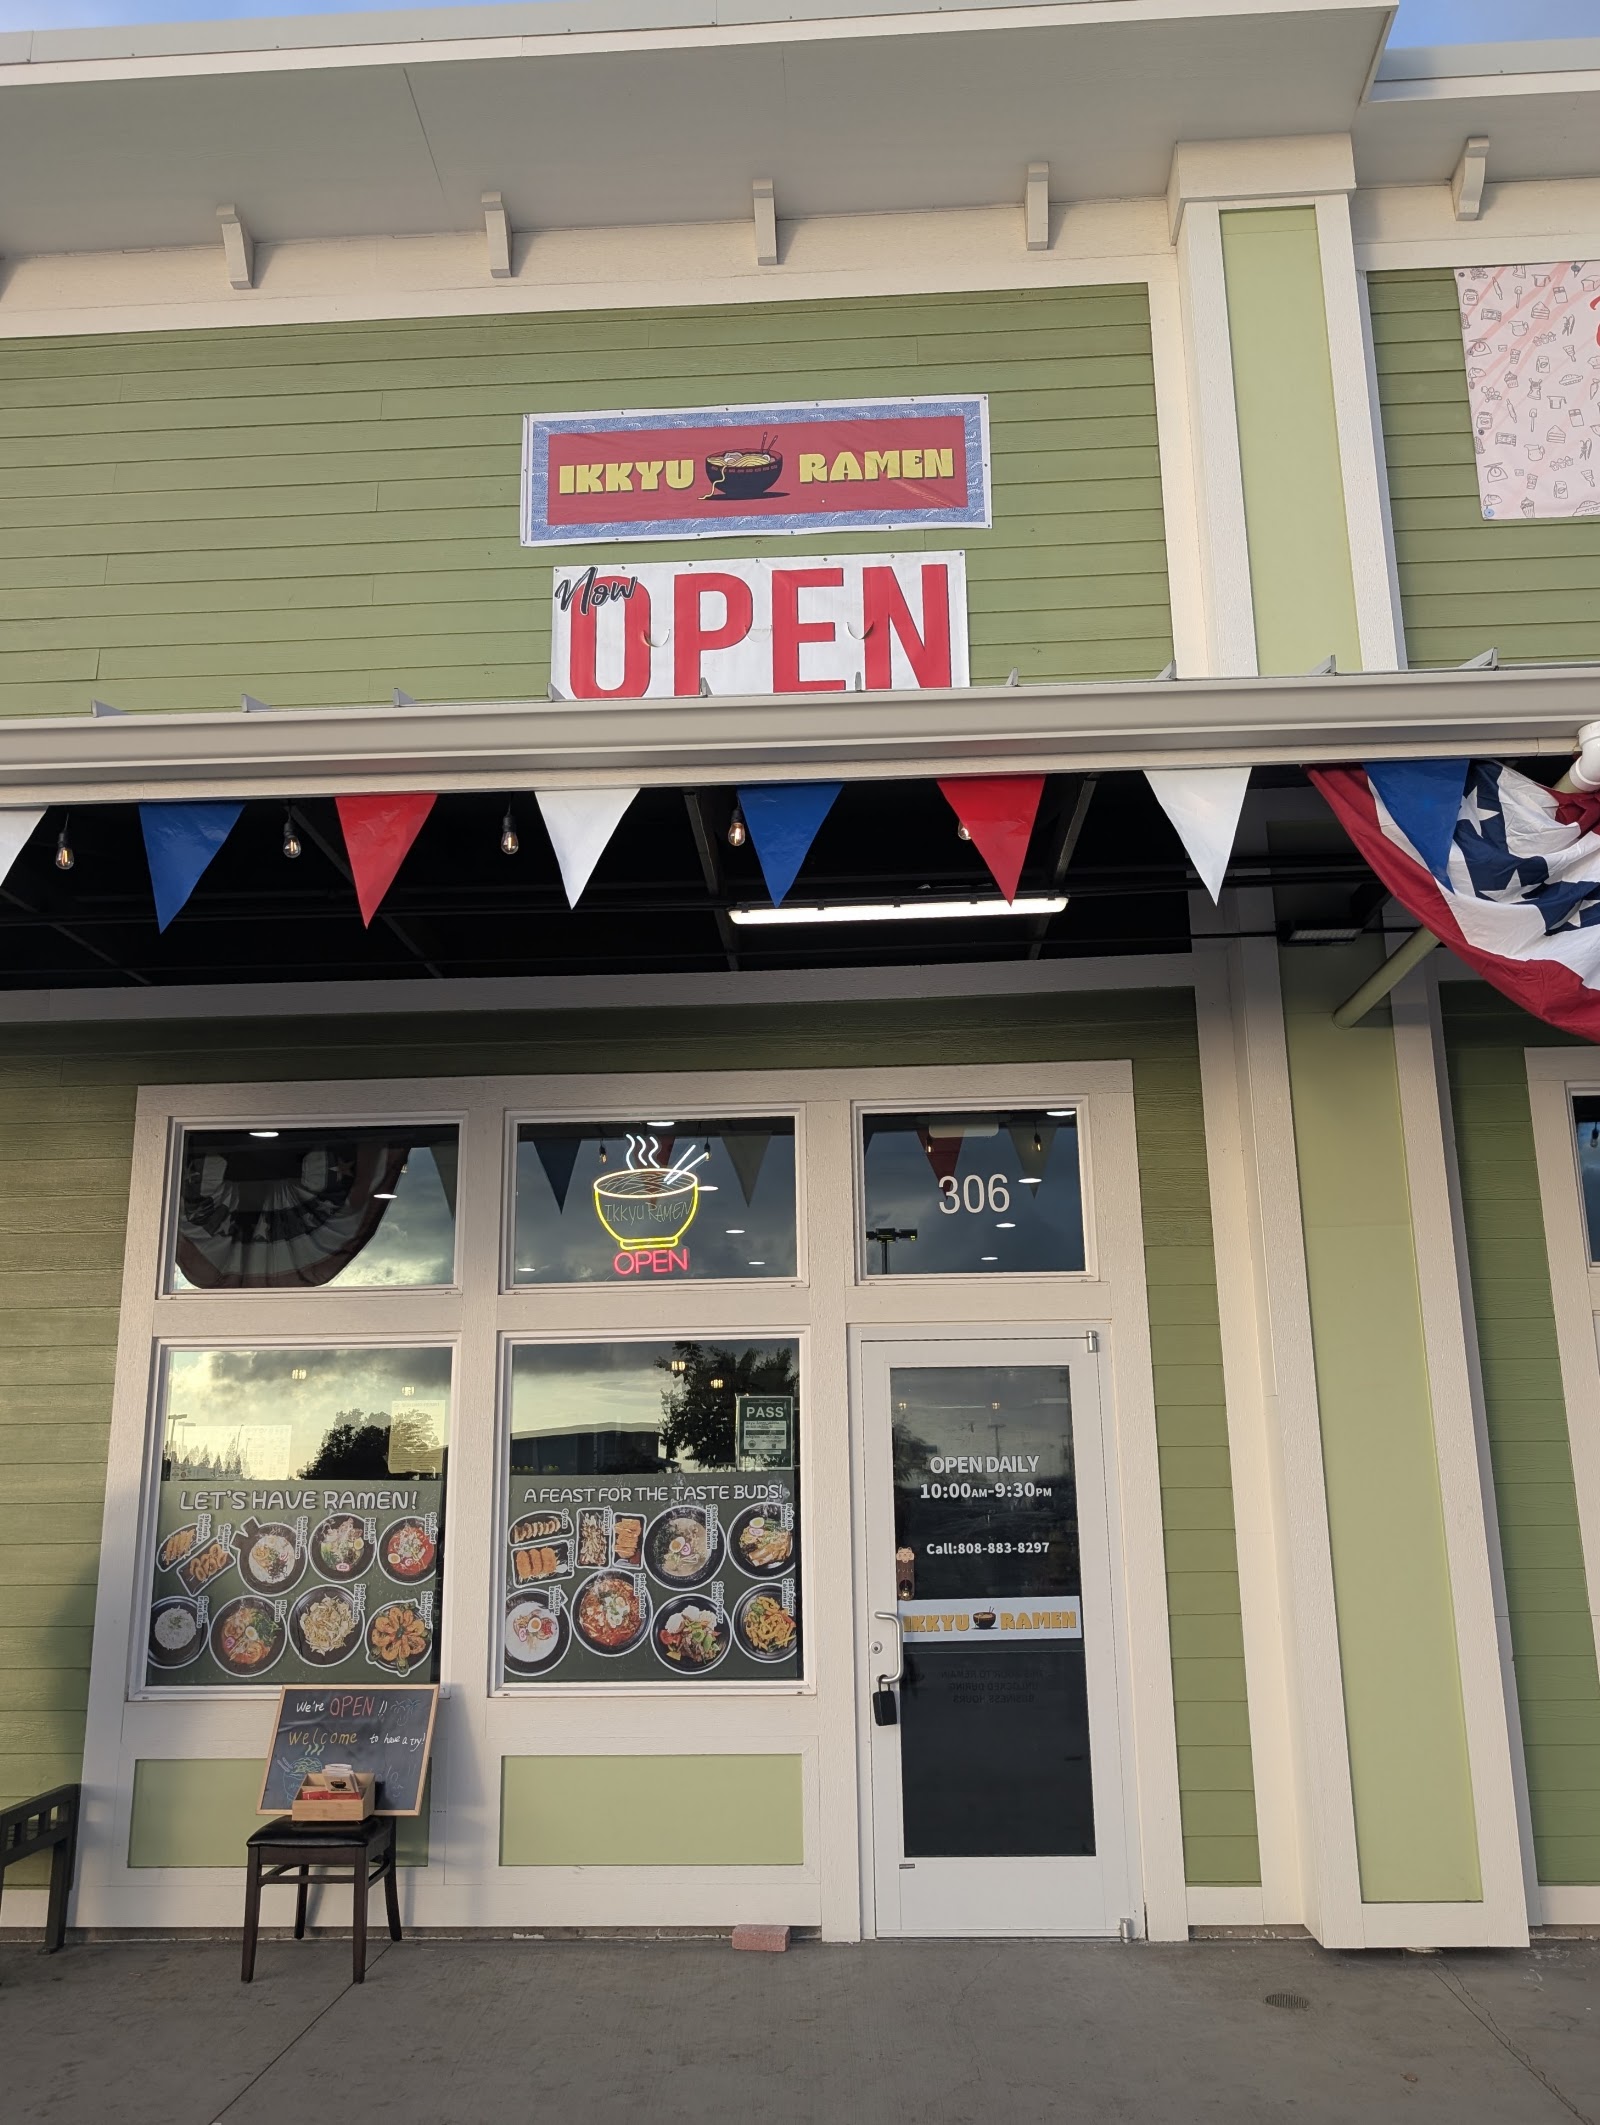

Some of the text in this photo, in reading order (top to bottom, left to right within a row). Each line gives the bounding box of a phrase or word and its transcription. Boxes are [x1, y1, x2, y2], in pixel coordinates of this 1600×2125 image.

[559, 448, 954, 494] IKKYU RAMEN
[554, 566, 637, 615] Now
[570, 563, 952, 699] OPEN
[938, 1173, 1010, 1214] 306
[604, 1197, 693, 1226] IKKYU RAMEN
[613, 1248, 689, 1275] OPEN
[746, 1406, 784, 1418] PASS
[930, 1455, 1040, 1474] OPEN DAILY
[180, 1490, 418, 1510] LET'S HAVE RAMEN!
[524, 1483, 784, 1503] A FEAST FOR THE TASTE BUDS!
[561, 1509, 569, 1528] Gyoza
[926, 1542, 1050, 1555] Call:808-883-8297
[903, 1611, 1077, 1633] IKKYU RAMEN
[296, 1700, 325, 1713] We're
[329, 1695, 375, 1718] OPEN
[369, 1733, 379, 1744] to
[383, 1733, 401, 1744] have
[401, 1736, 408, 1745] a
